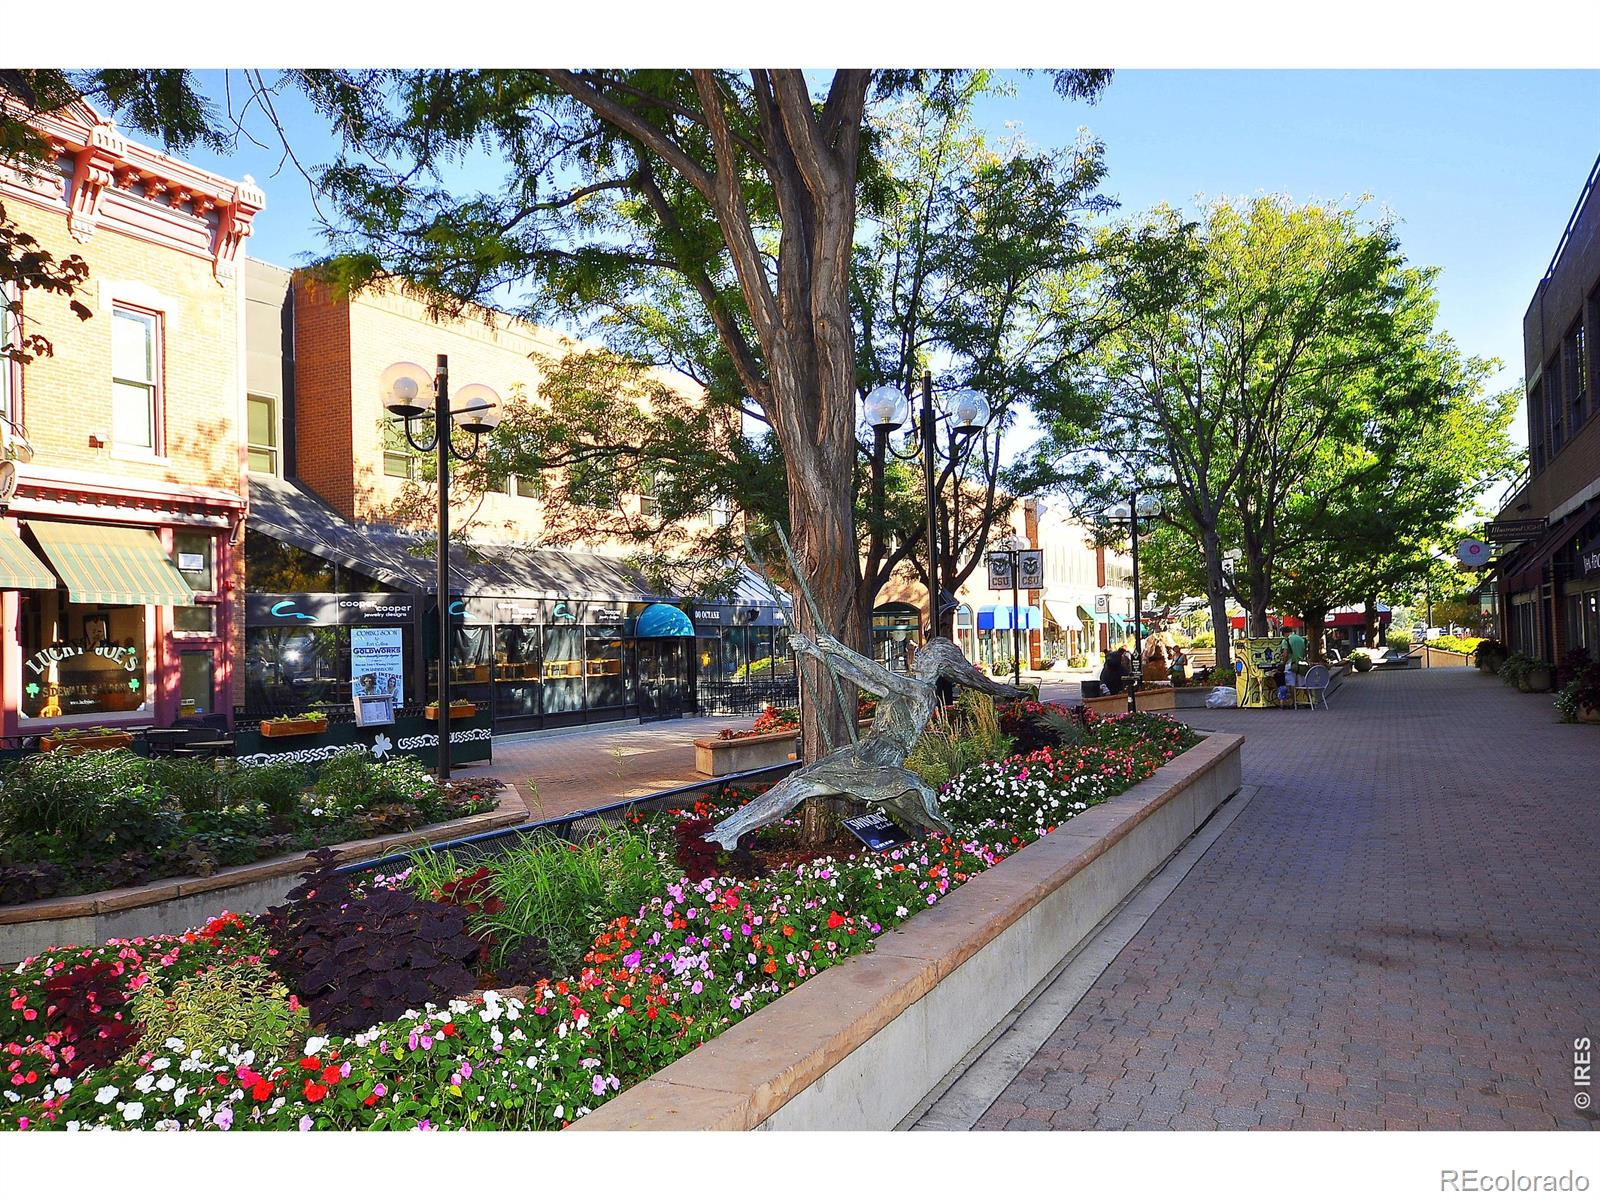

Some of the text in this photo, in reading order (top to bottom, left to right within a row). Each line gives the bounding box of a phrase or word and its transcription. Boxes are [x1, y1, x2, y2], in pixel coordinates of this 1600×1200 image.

[991, 577, 1009, 586] CSU
[1021, 576, 1039, 585] CSU
[339, 601, 377, 609] cooper
